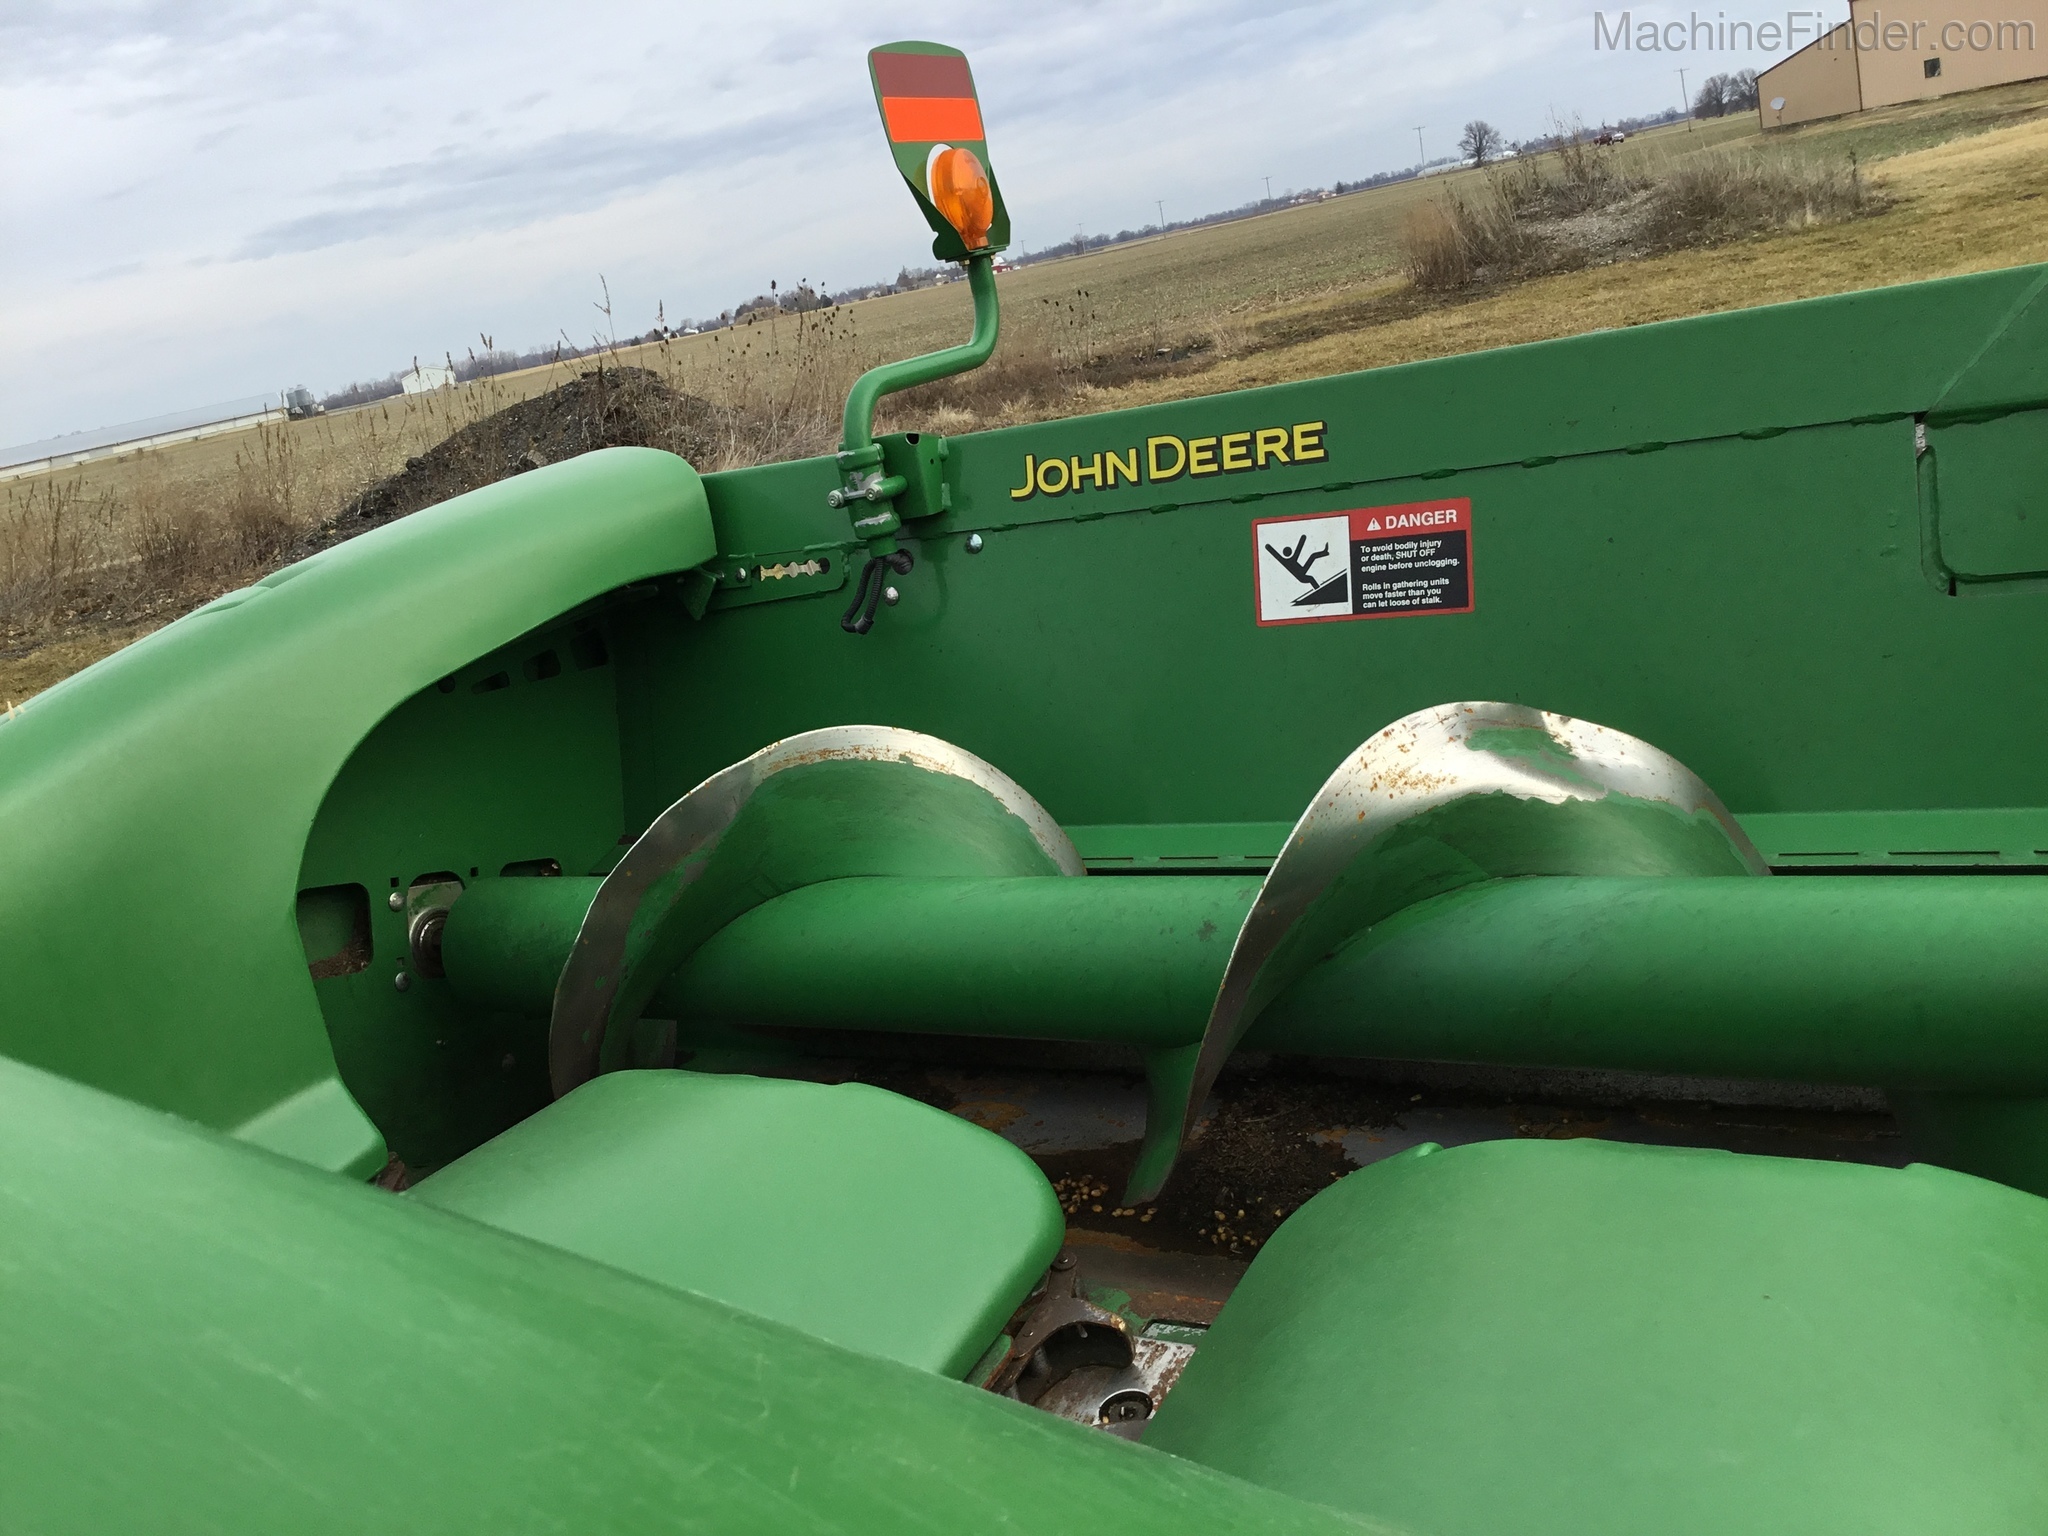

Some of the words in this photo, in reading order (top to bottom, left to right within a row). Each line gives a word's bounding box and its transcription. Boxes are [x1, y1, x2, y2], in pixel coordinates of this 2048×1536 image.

[1010, 447, 1142, 500] JOHN
[1146, 420, 1328, 484] DEERE
[1386, 509, 1457, 529] DANGER
[1372, 543, 1392, 552] avoid
[1394, 541, 1418, 550] bodily
[1420, 540, 1442, 548] injury
[1371, 553, 1394, 561] death,
[1396, 550, 1417, 559] SHUT
[1419, 549, 1435, 557] OFF
[1361, 564, 1386, 573] engine
[1389, 562, 1412, 570] before
[1415, 558, 1460, 568] unclogging.
[1362, 583, 1381, 591] Rolls
[1392, 579, 1428, 590] gathering
[1430, 578, 1449, 586] units
[1385, 590, 1406, 598] faster
[1427, 588, 1441, 596] you
[1412, 597, 1420, 605] of
[1422, 596, 1442, 604] stalk.
